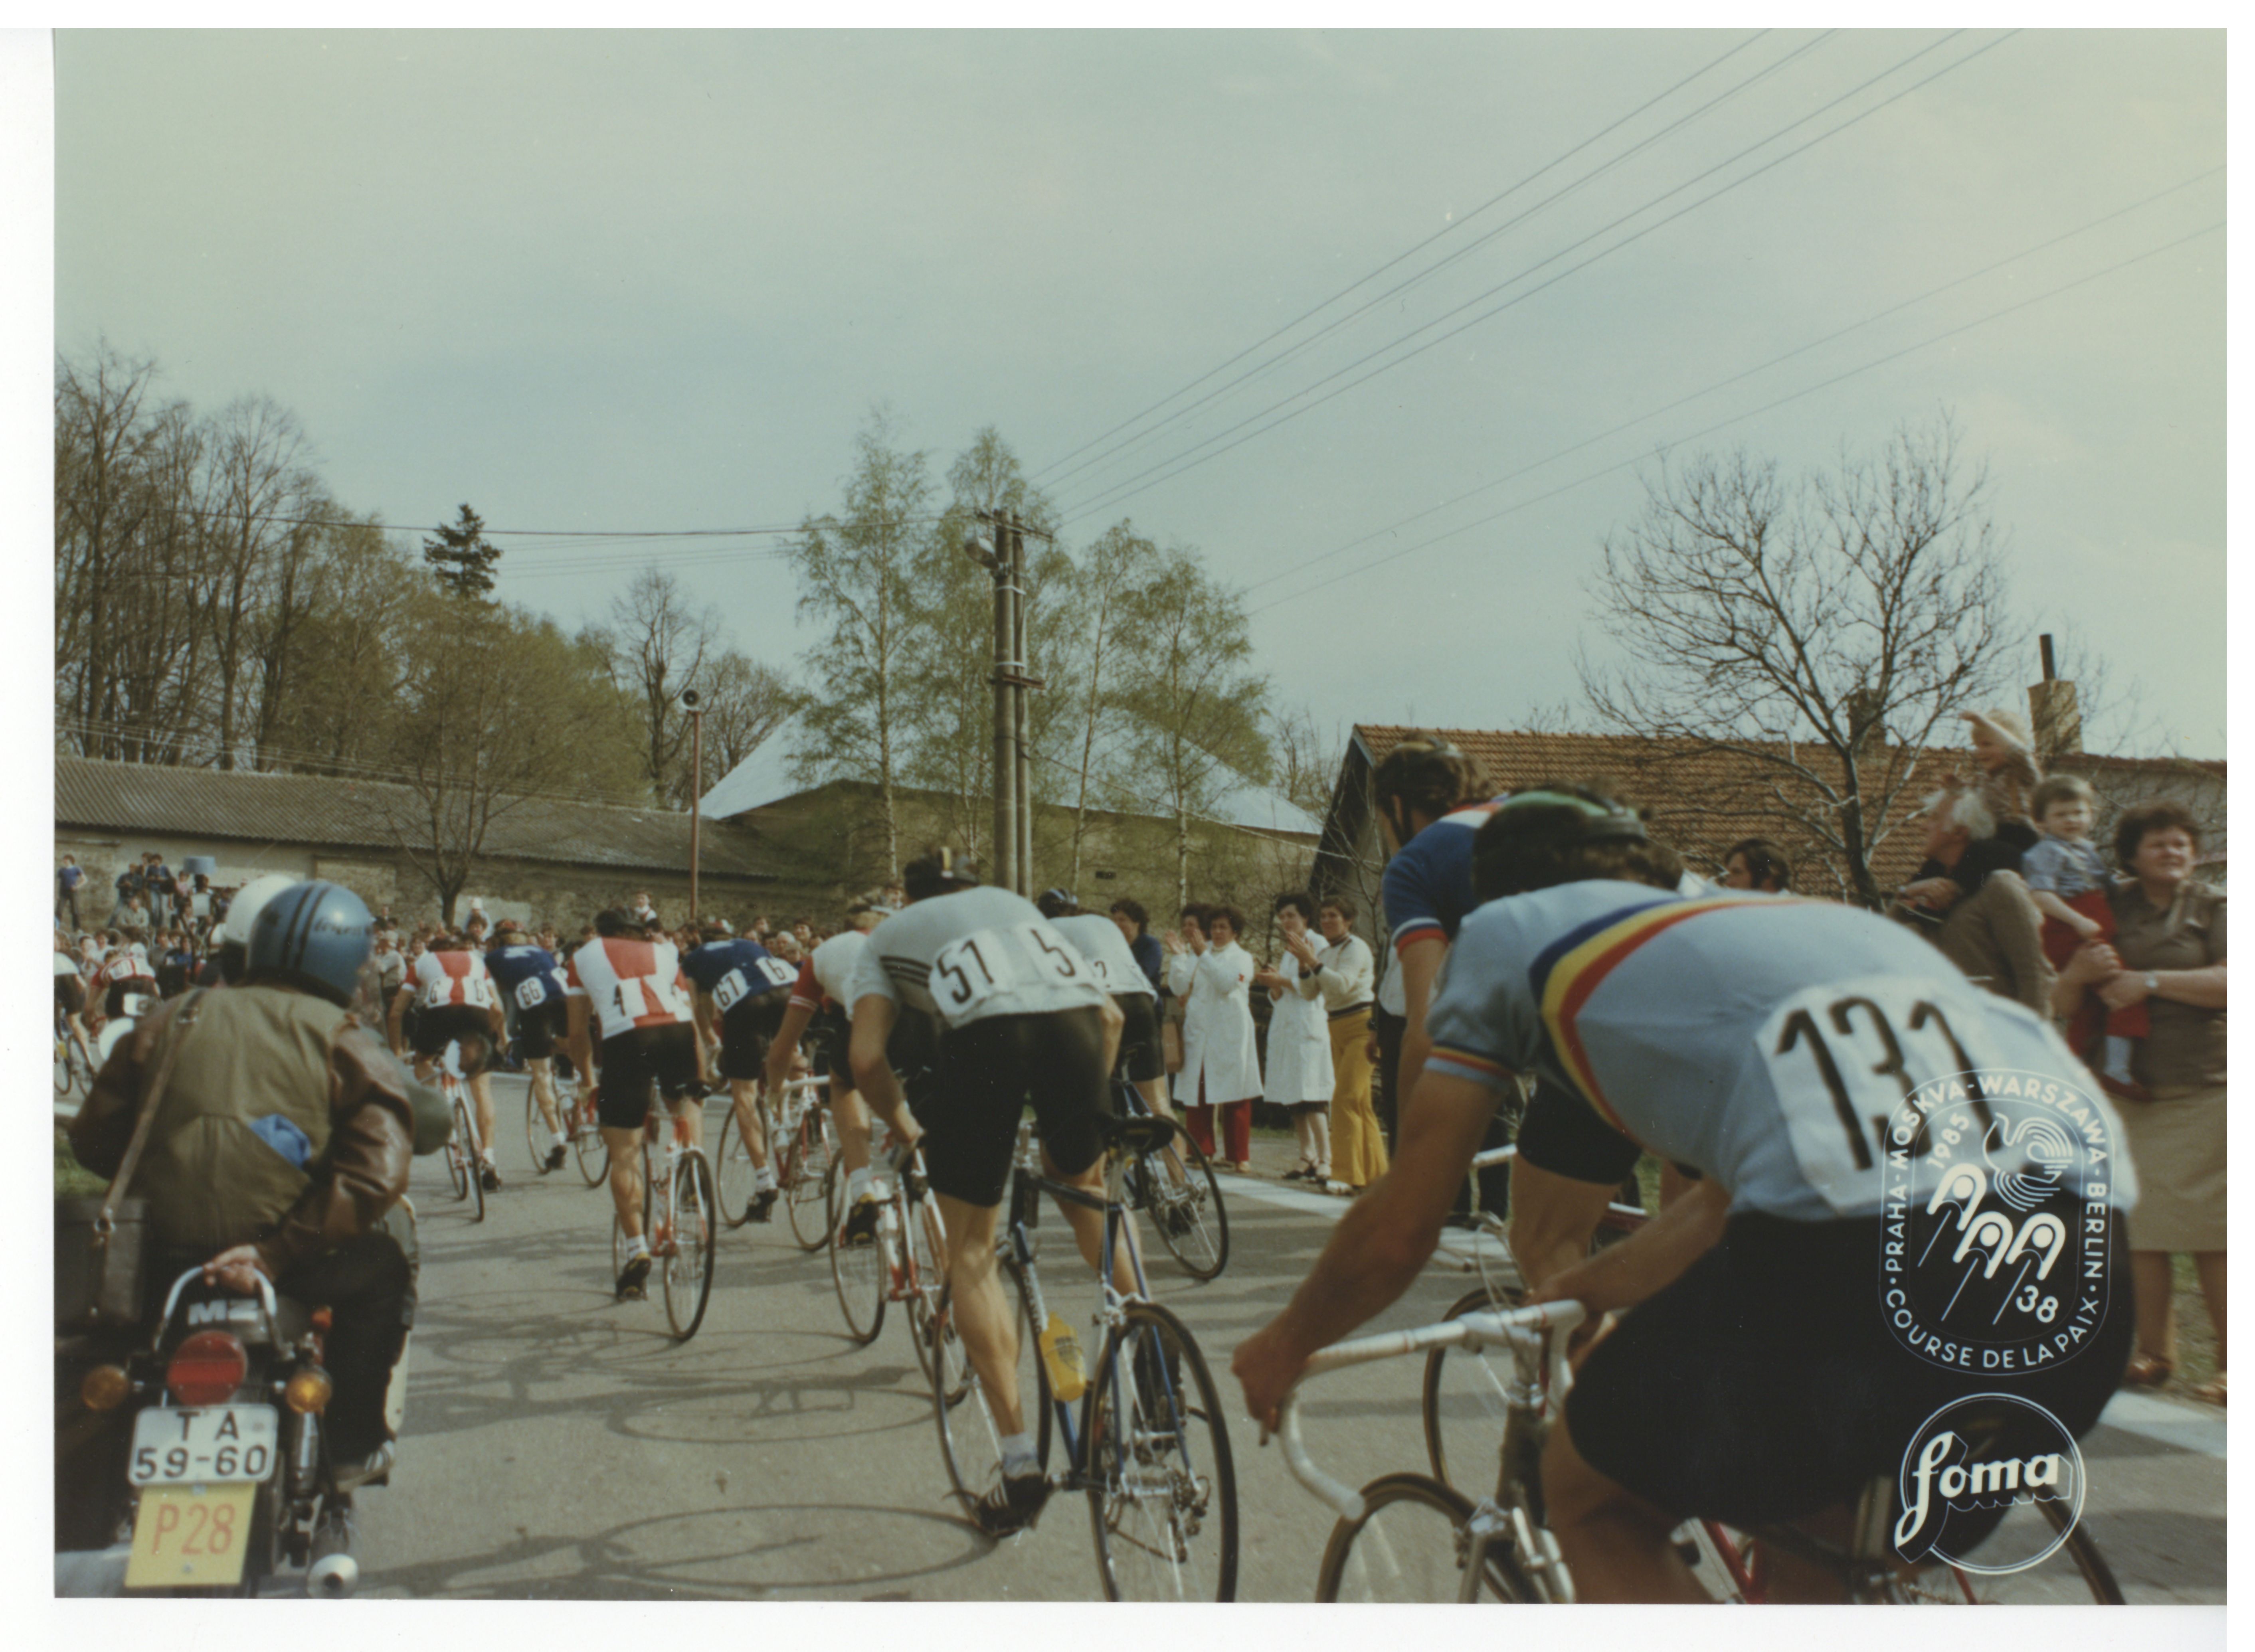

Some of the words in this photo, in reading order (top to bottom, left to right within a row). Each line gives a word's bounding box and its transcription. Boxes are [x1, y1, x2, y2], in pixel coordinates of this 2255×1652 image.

[520, 980, 541, 1006] 66
[1774, 996, 2003, 1172] 131
[188, 1300, 258, 1325] MZ
[135, 1445, 267, 1480] 59-60
[152, 1503, 236, 1556] P28
